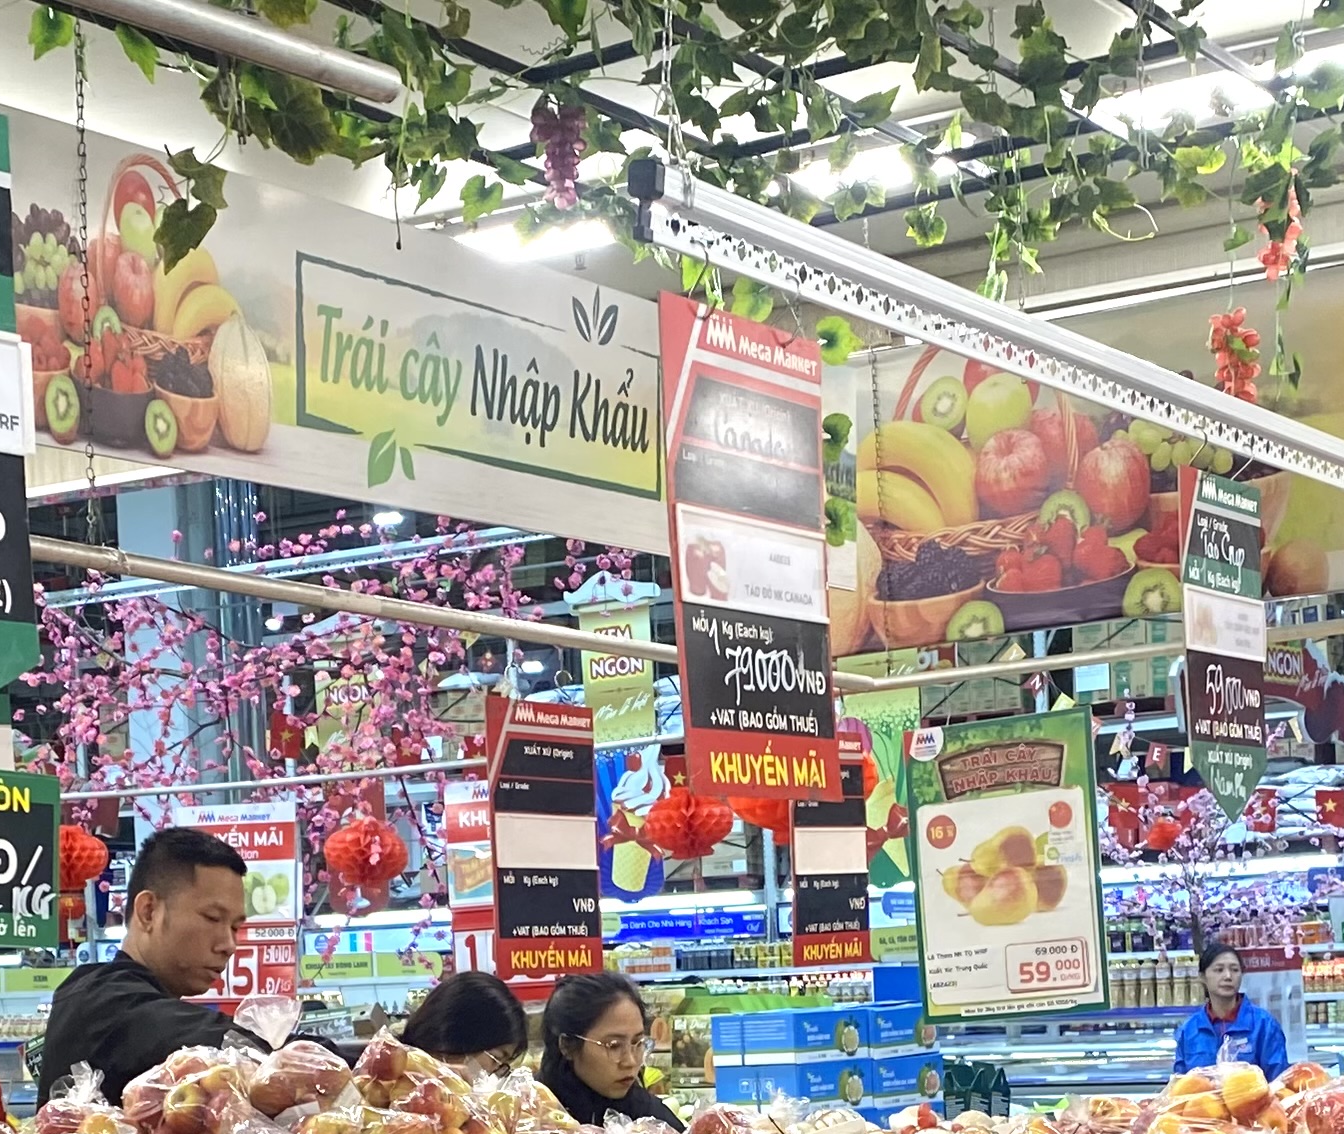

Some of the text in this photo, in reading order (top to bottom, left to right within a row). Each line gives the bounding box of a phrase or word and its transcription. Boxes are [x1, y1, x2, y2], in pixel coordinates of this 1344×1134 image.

[316, 304, 651, 454] Trái cây Nhập Khẩu
[590, 655, 645, 680] NGON
[739, 709, 763, 731] (BAO
[765, 706, 787, 732] GỒM
[790, 710, 819, 736] THUẾ)
[710, 740, 827, 789] KHUYẾN MÃI
[960, 742, 1037, 770] TRÁI CÂY
[1152, 749, 1162, 761] E
[953, 770, 998, 794] NHẬP
[254, 827, 284, 848] MÃI
[572, 898, 596, 913] VNĐ
[13, 919, 37, 938] lên
[511, 941, 592, 970] KHUYẾN MÃI
[803, 936, 862, 961] KHUYẾN MÃI
[1056, 959, 1081, 970] 000
